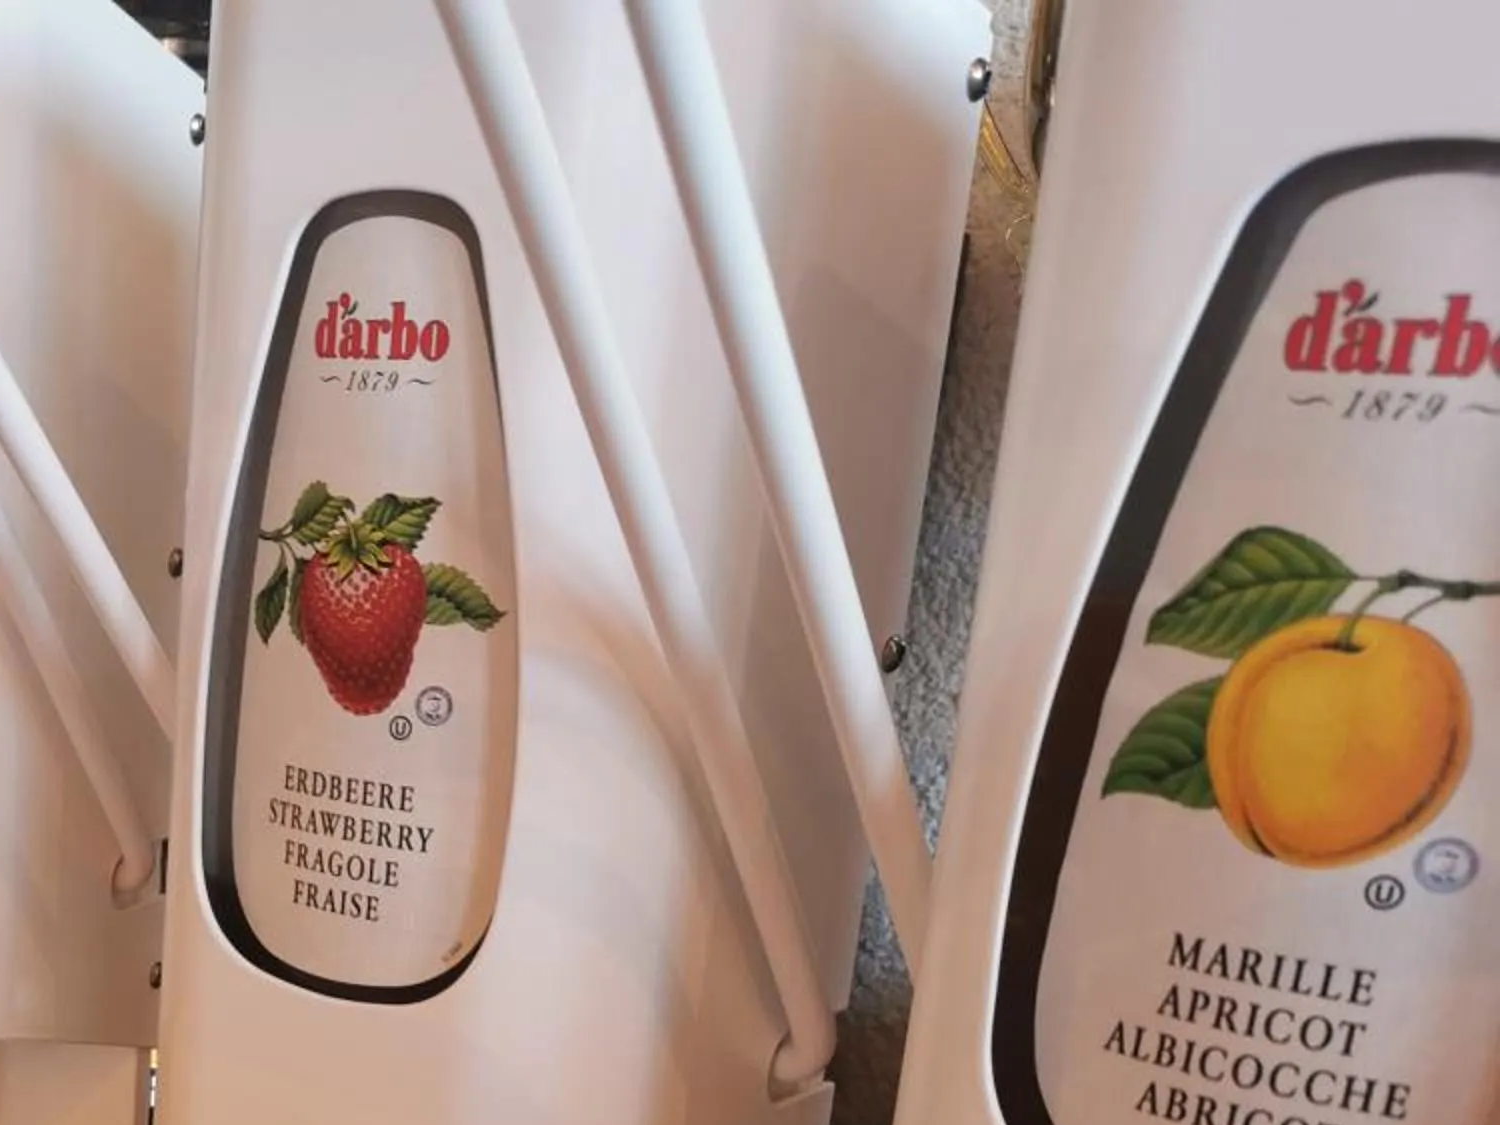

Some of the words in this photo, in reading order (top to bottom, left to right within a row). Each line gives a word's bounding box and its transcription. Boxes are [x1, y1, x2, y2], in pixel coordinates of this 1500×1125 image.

[346, 370, 399, 392] 1879
[1341, 390, 1448, 423] 1879
[284, 764, 415, 814] ERDBEERE
[268, 797, 435, 854] STRAWBERRY
[283, 839, 400, 888] FRAGOLE
[292, 879, 380, 922] FRAISE
[1166, 931, 1378, 1008] MARILLE
[1156, 982, 1367, 1058] APRICOT
[1103, 1020, 1412, 1121] ALBICOCCHE
